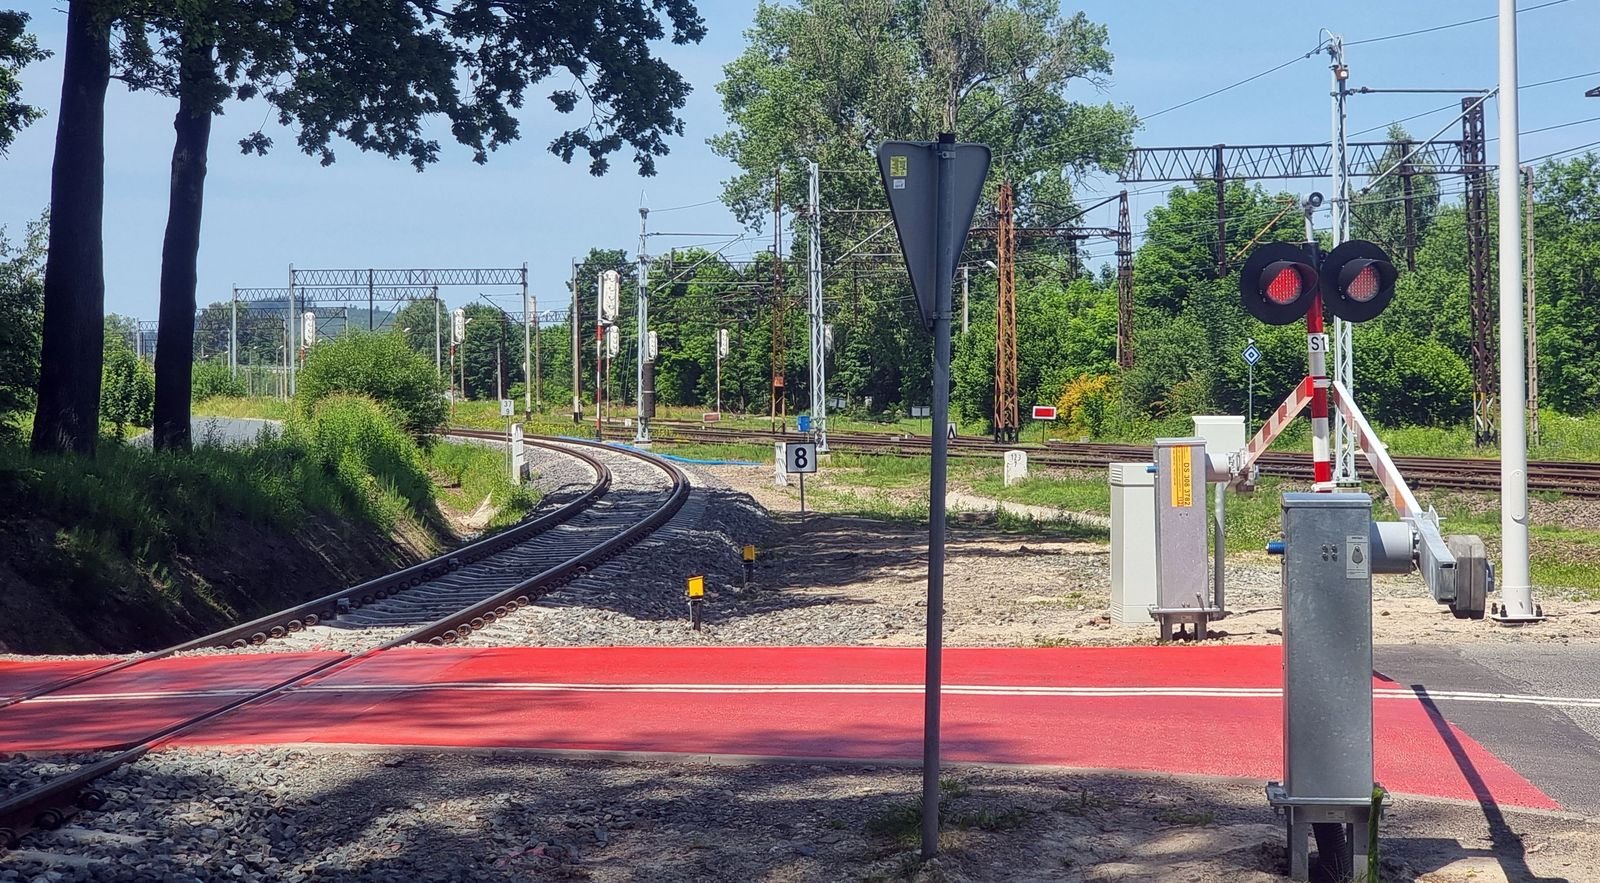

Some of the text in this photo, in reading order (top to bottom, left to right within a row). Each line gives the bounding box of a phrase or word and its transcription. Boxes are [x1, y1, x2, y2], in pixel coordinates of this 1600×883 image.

[1311, 336, 1326, 351] S1
[503, 400, 513, 408] 37
[795, 447, 808, 469] 8
